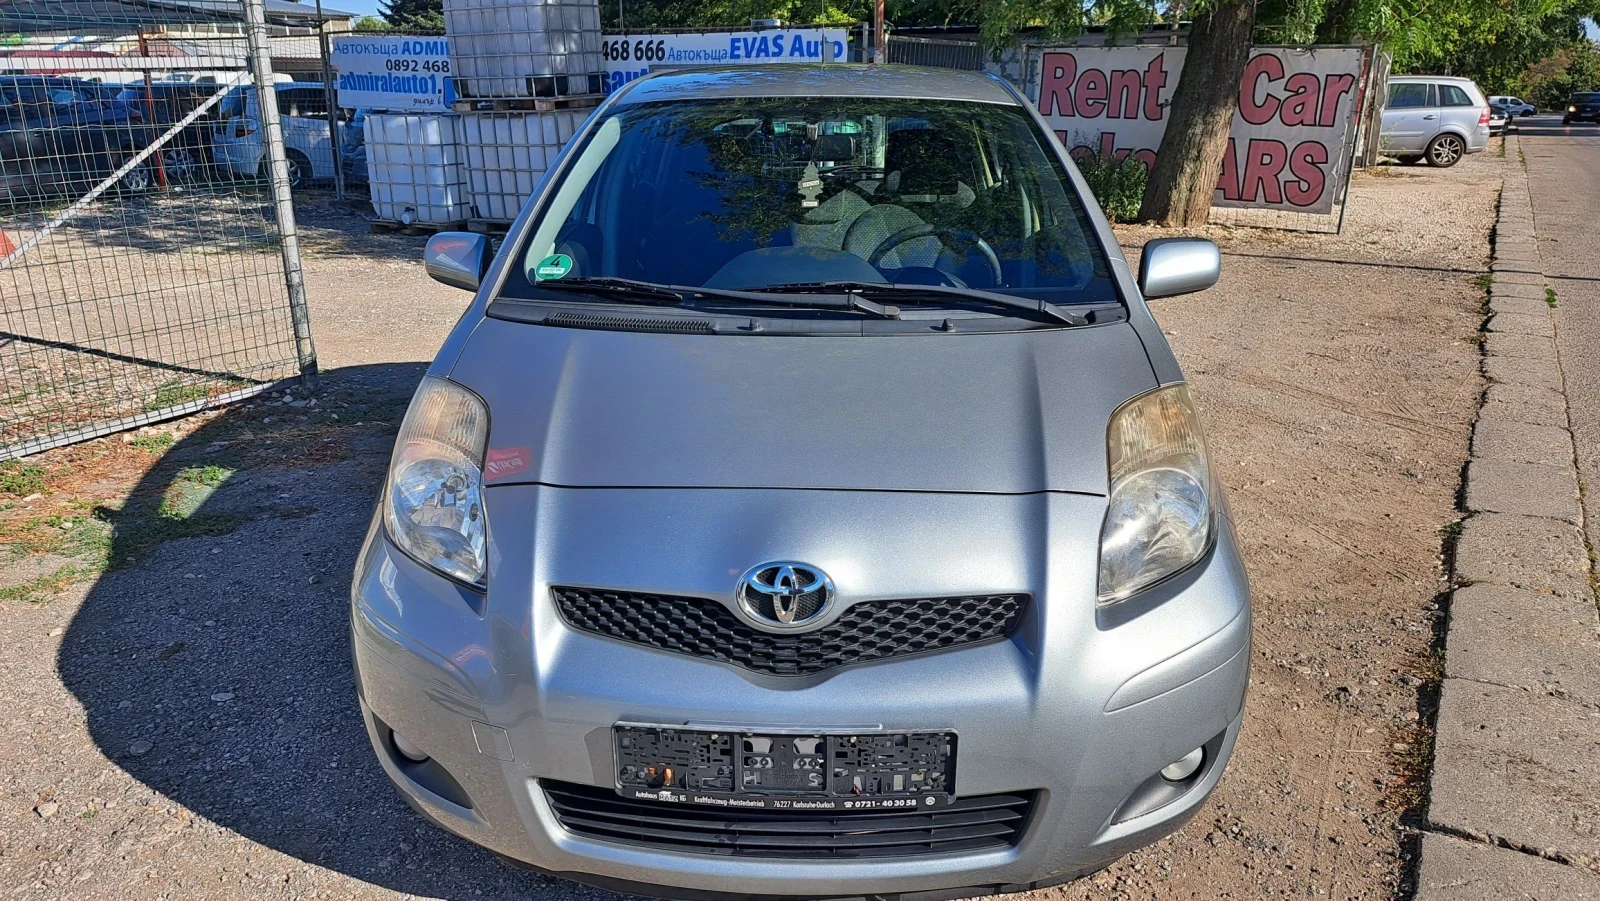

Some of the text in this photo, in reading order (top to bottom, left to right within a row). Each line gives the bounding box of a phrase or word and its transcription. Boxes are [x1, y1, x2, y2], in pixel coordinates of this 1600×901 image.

[333, 40, 399, 56] Автокъща
[603, 39, 666, 61] 468 666
[667, 46, 728, 63] Автокъща
[730, 34, 784, 60] EVAS
[385, 58, 451, 73] 0892 468
[1038, 51, 1168, 121] Rent
[1238, 53, 1355, 128] Car
[549, 255, 562, 267] 4
[635, 790, 658, 800] Autohaus
[773, 800, 791, 808] 76227
[905, 799, 917, 807] 58
